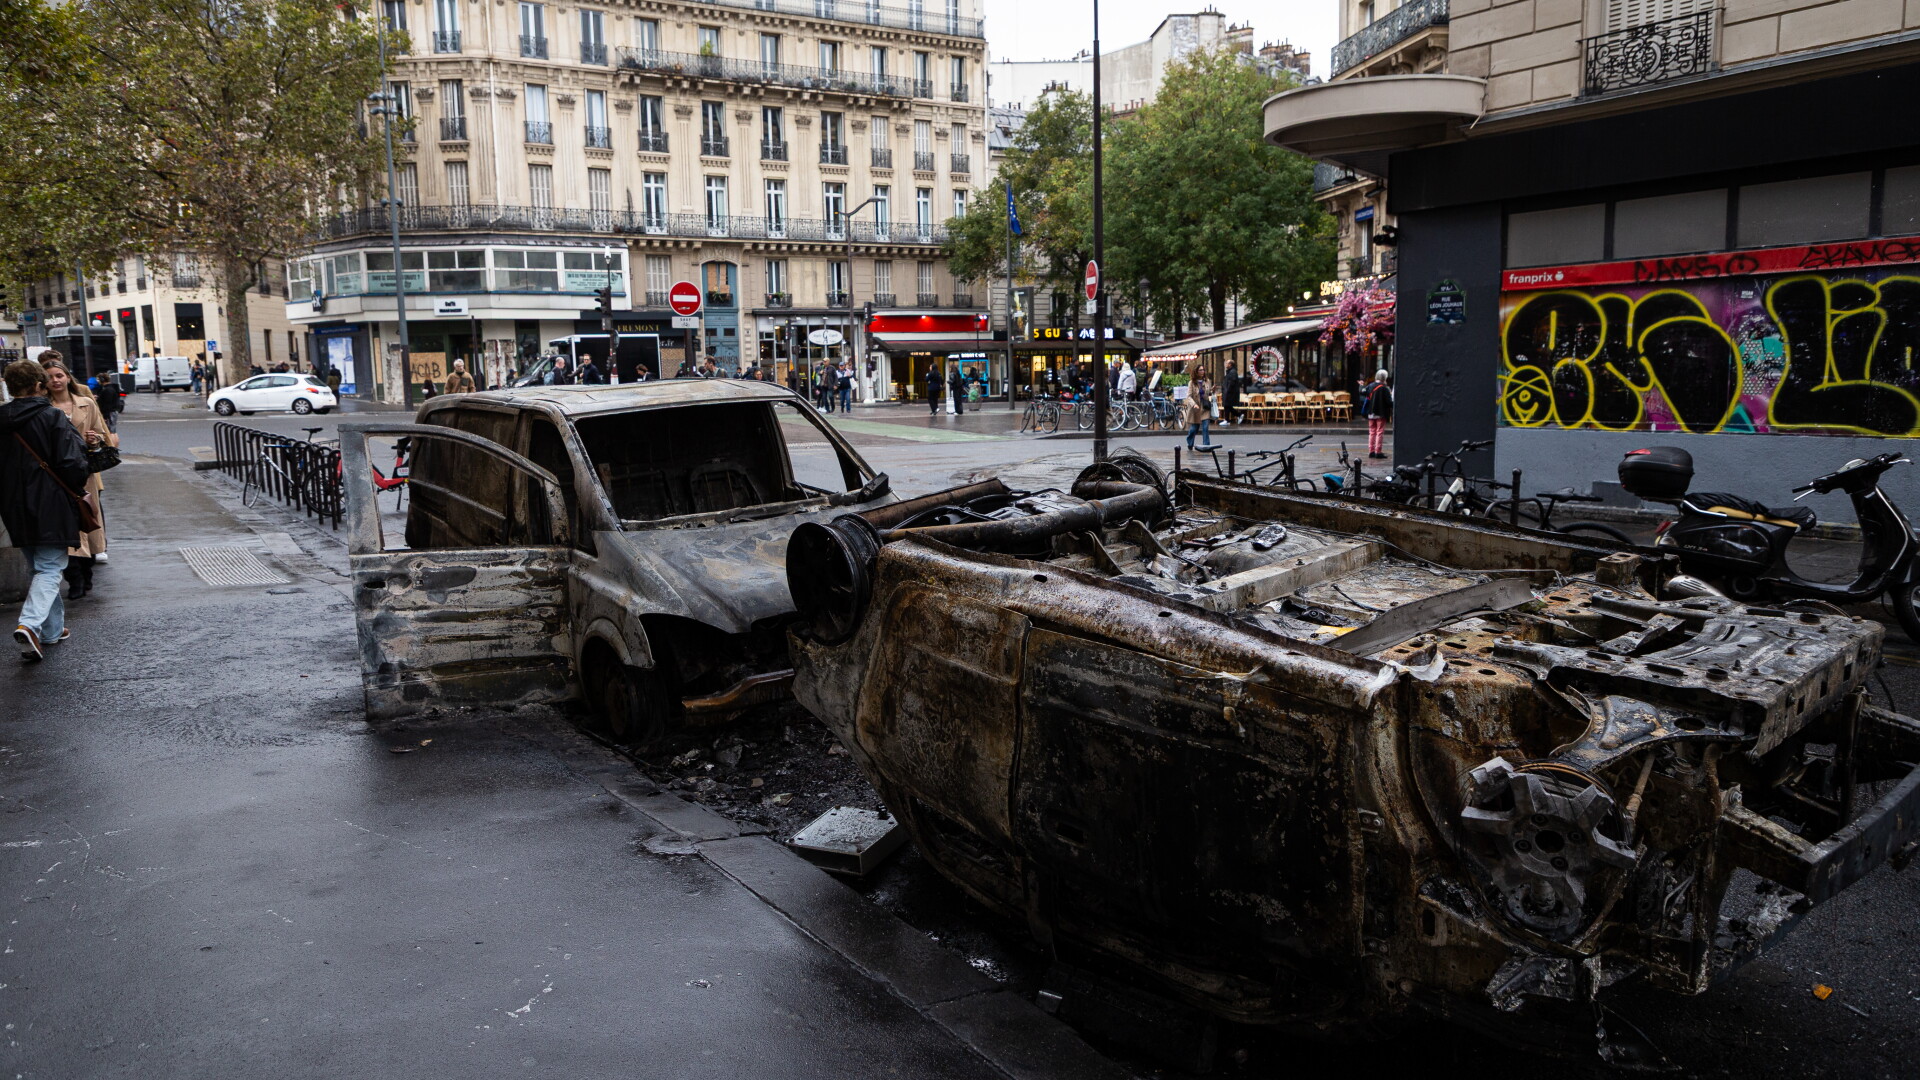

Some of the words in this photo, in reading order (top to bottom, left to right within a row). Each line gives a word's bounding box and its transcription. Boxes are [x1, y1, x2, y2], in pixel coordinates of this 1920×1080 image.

[1509, 271, 1553, 285] franprix
[617, 324, 659, 332] FREMONT
[1044, 328, 1060, 338] GU
